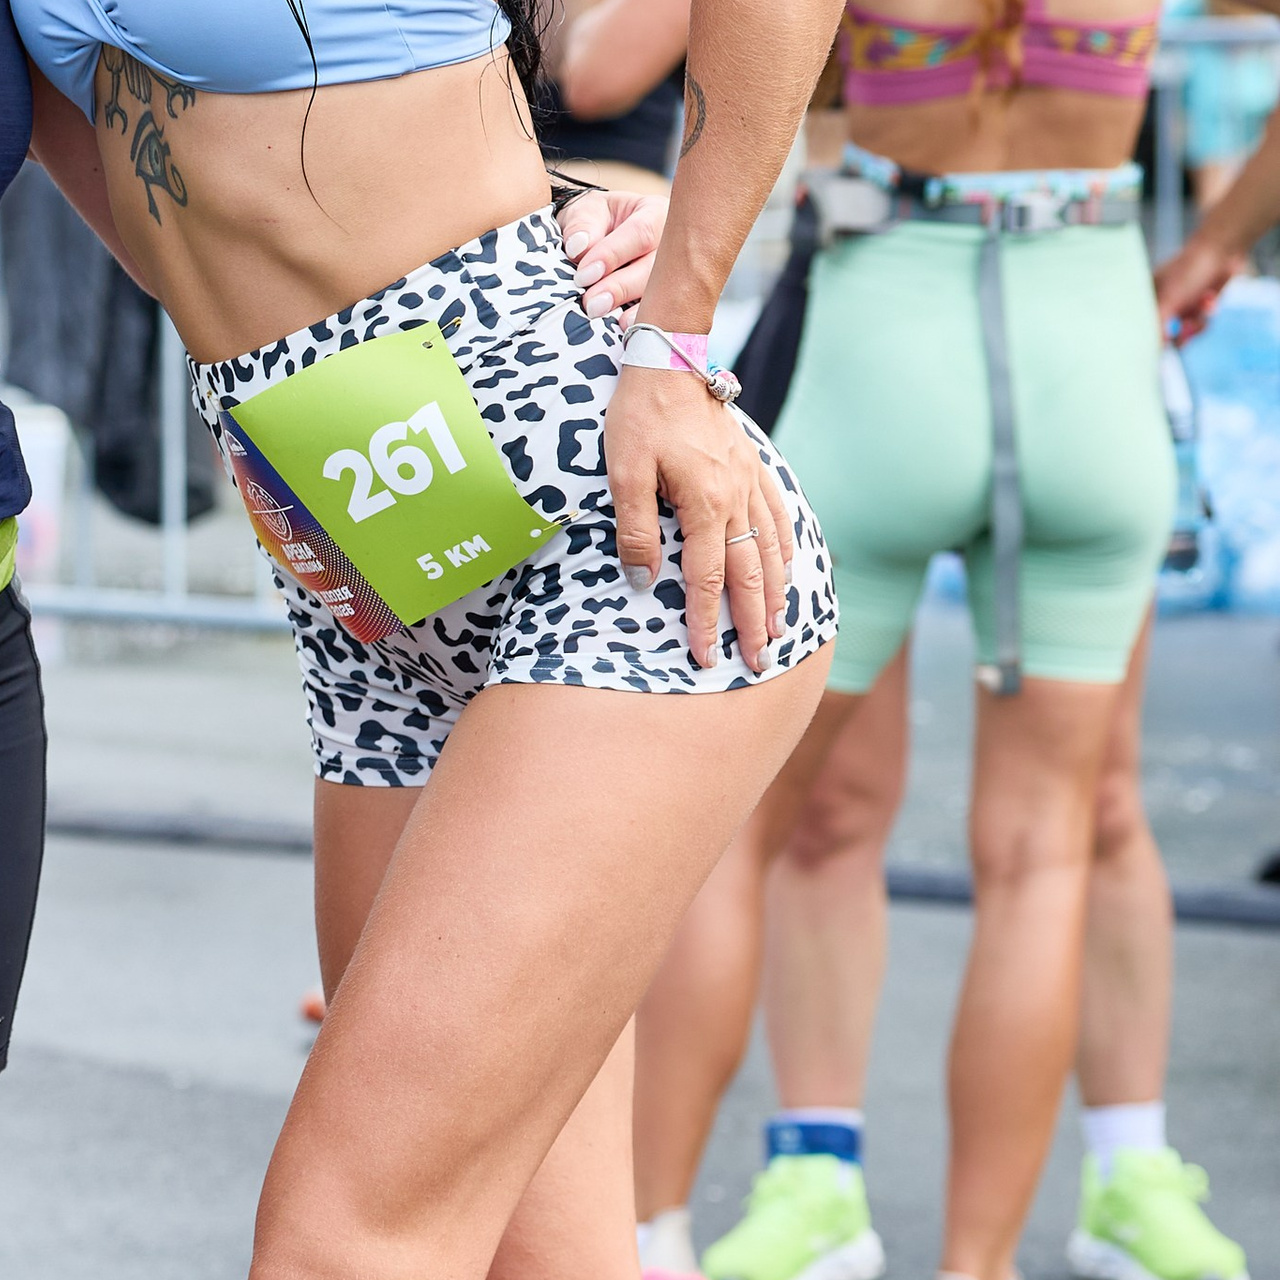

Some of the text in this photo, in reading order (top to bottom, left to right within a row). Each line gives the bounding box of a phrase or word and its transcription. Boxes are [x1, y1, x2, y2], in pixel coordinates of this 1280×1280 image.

[322, 400, 468, 524] 261
[416, 533, 493, 581] 5 КМ
